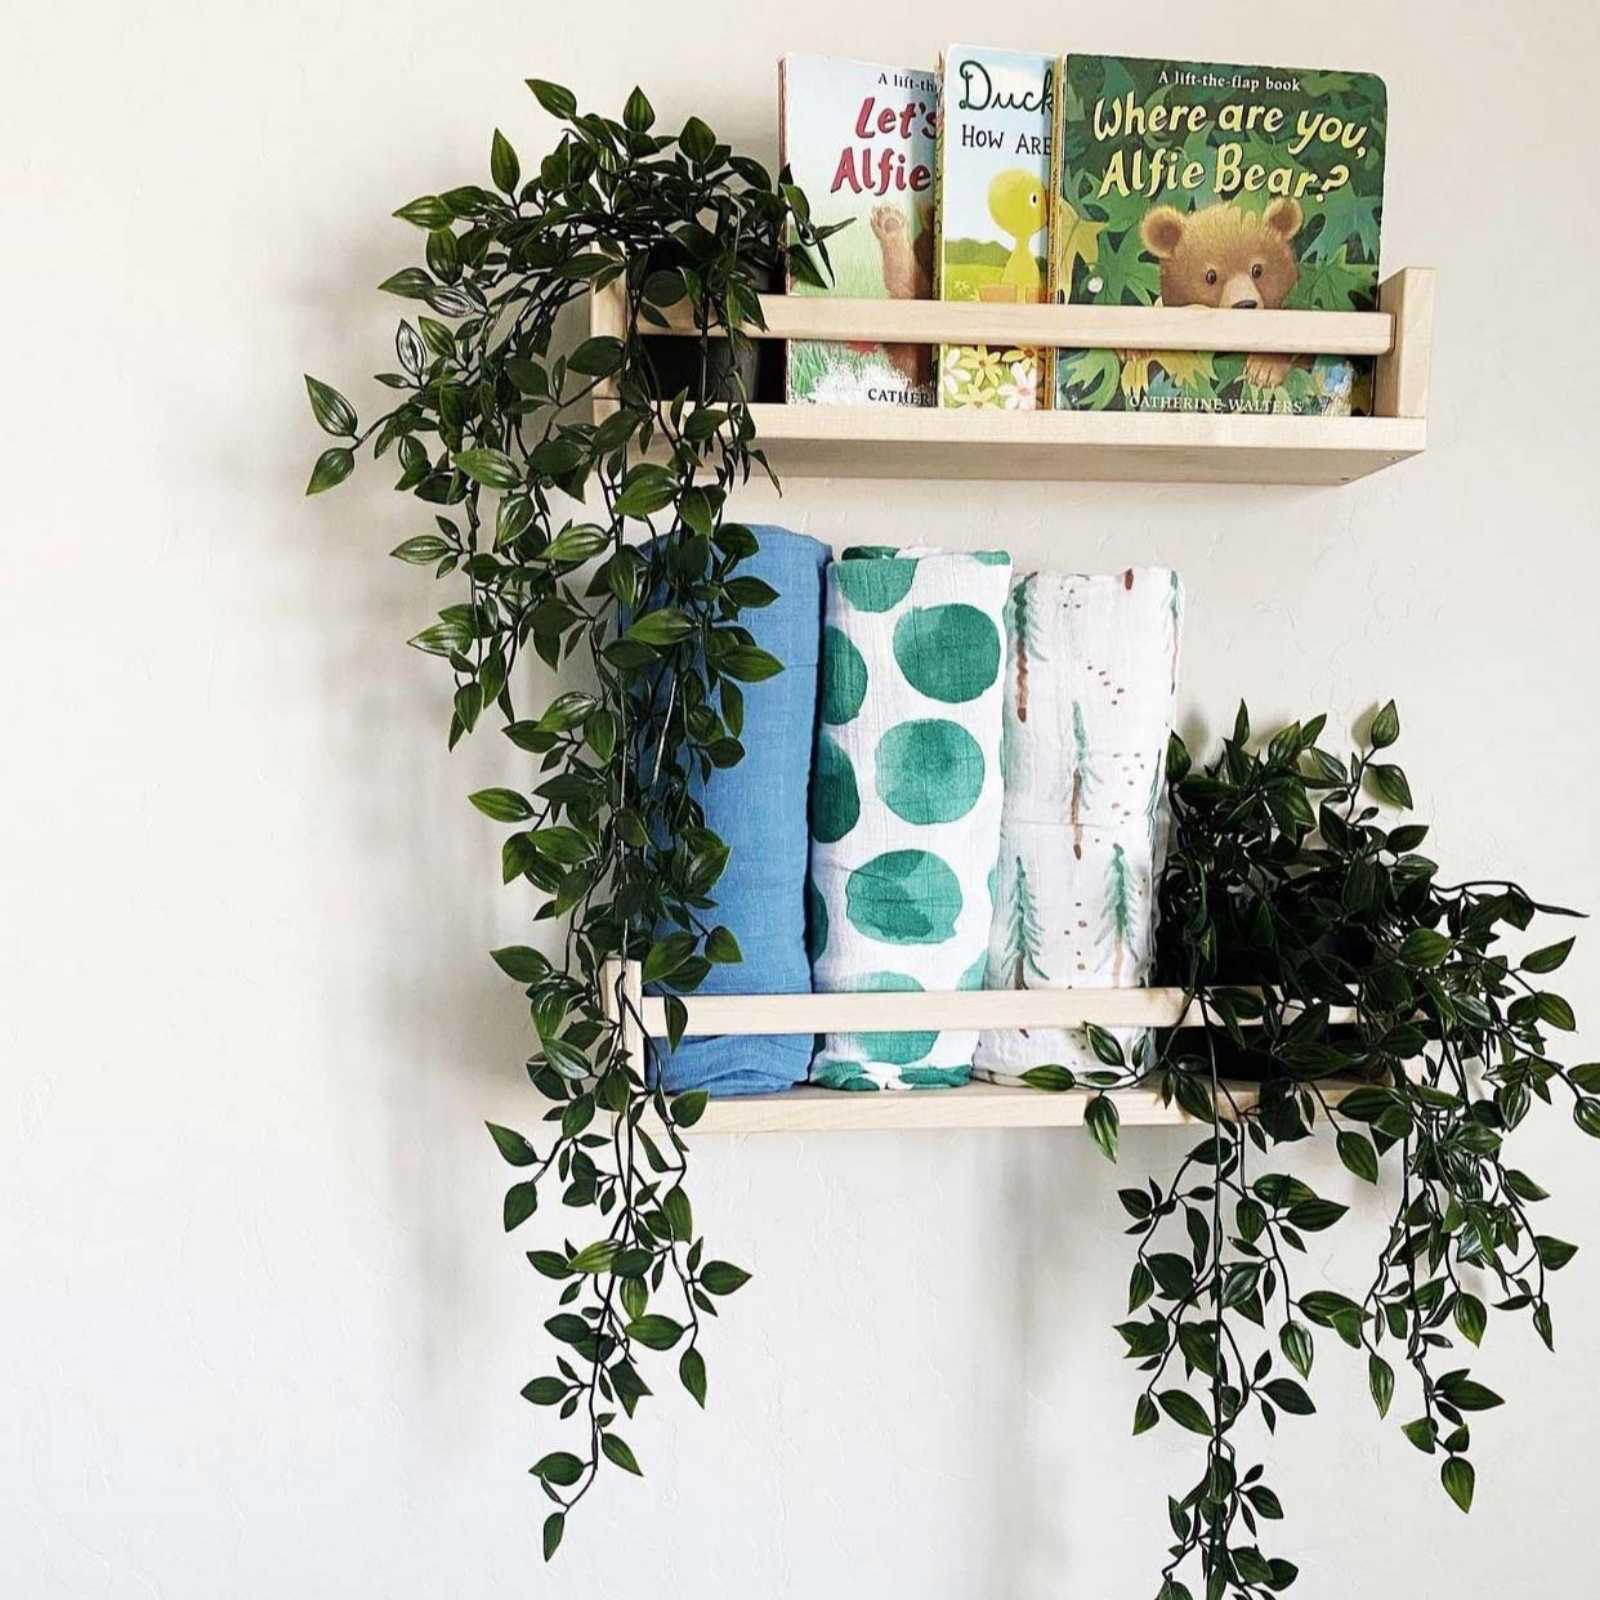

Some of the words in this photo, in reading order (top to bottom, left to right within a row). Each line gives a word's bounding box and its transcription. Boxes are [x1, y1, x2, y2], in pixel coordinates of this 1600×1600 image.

[878, 72, 887, 85] A
[894, 73, 938, 92] lift-th
[959, 60, 1054, 115] Duck
[1159, 71, 1168, 84] A
[1174, 71, 1260, 93] lift-the-flap
[1265, 76, 1301, 92] book
[856, 97, 937, 140] Let's
[962, 124, 1004, 149] HOW
[1015, 133, 1052, 155] ARE
[1093, 90, 1208, 142] Where
[1217, 103, 1284, 133] are
[1287, 109, 1368, 160] you,
[831, 146, 932, 197] Alfie
[1097, 147, 1206, 198] Alfie
[1212, 141, 1351, 202] Bear?
[1129, 395, 1222, 411] CATHERINE
[1228, 398, 1304, 414] WALTERS
